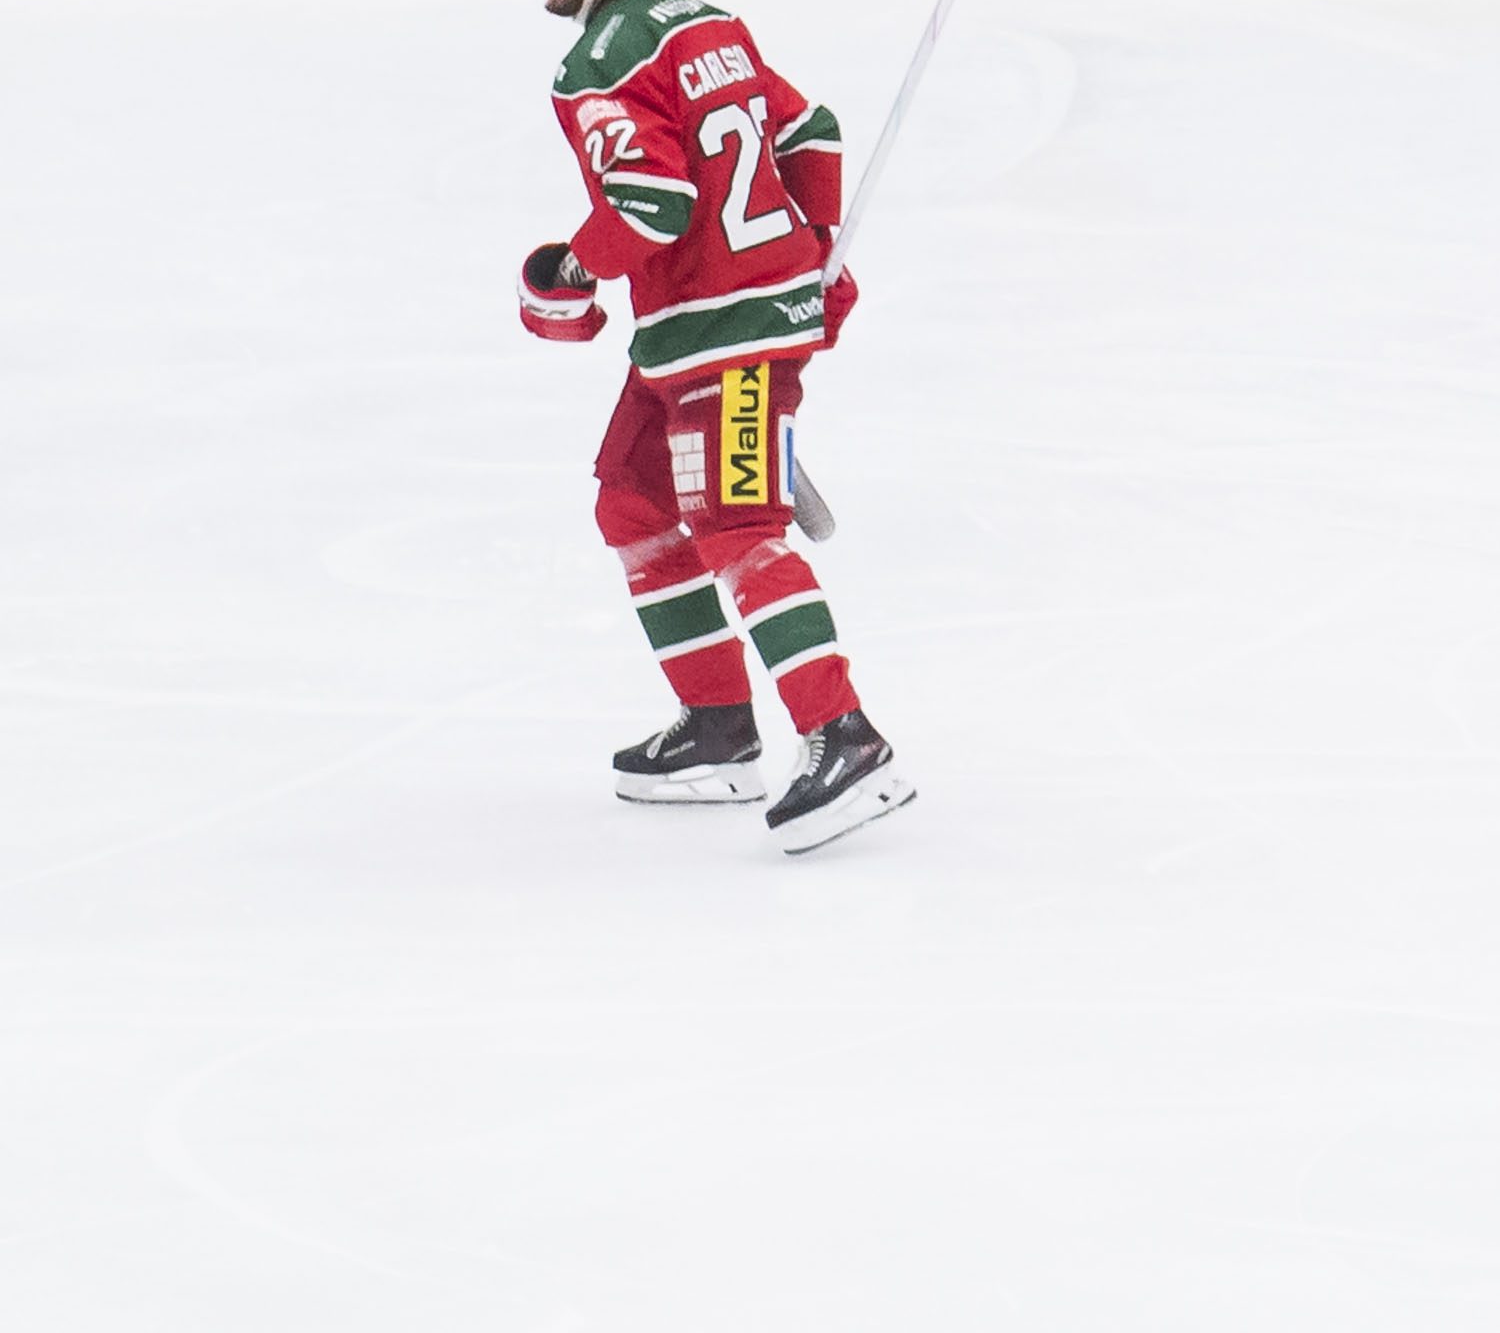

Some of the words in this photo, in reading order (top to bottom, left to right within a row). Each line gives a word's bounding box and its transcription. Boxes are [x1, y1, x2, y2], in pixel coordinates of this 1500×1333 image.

[585, 119, 645, 174] 22
[698, 96, 812, 252] 2
[731, 366, 759, 497] Malux
